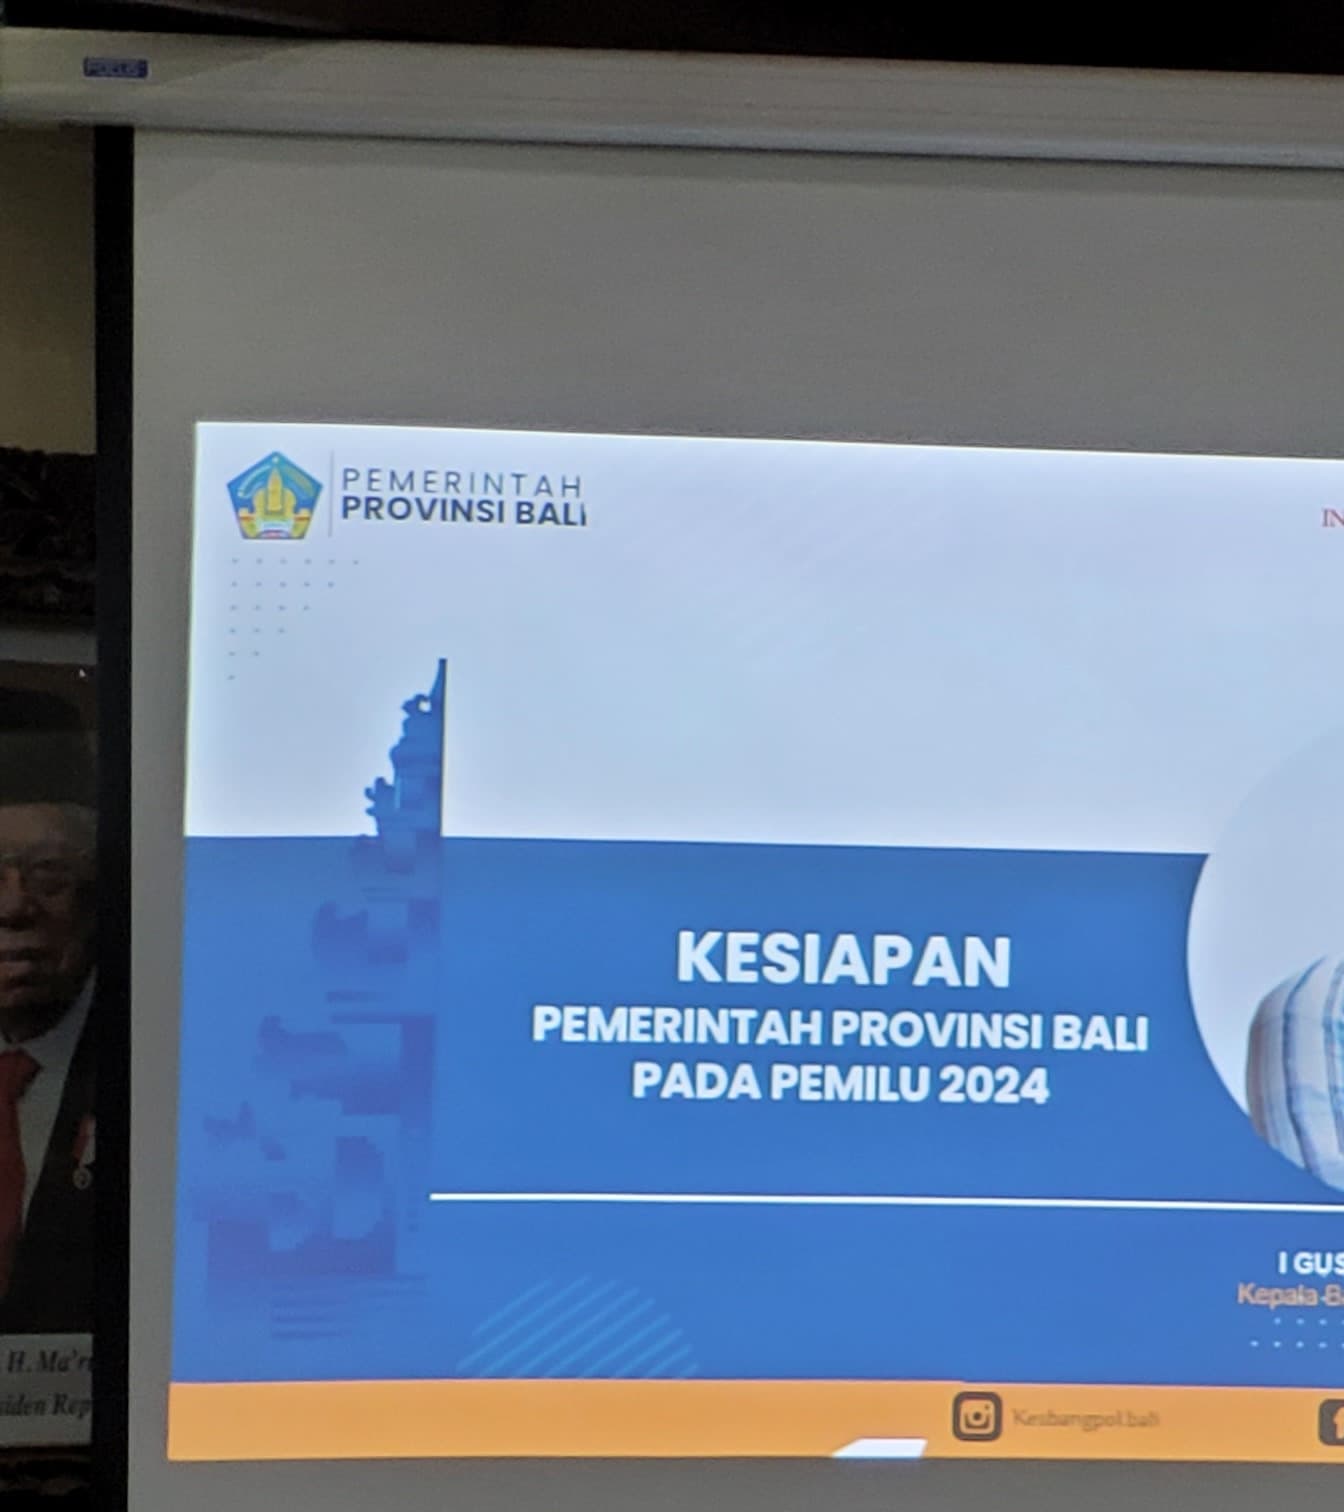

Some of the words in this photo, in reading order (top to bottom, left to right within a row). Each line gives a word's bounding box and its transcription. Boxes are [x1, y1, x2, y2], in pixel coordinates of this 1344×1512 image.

[342, 467, 581, 498] PEMERINTAH
[342, 496, 505, 524] PROVINSI
[515, 500, 587, 527] BALI
[677, 930, 1012, 988] KESIAPAN
[532, 1005, 823, 1046] PEMERINTAH
[832, 1009, 1043, 1050] PROVINSI
[1052, 1014, 1150, 1052] BALI
[632, 1061, 762, 1100] PADA
[771, 1065, 931, 1103] PEMILU
[939, 1066, 1051, 1104] 2024
[1278, 1252, 1287, 1275] I
[1237, 1282, 1318, 1310] Kepala
